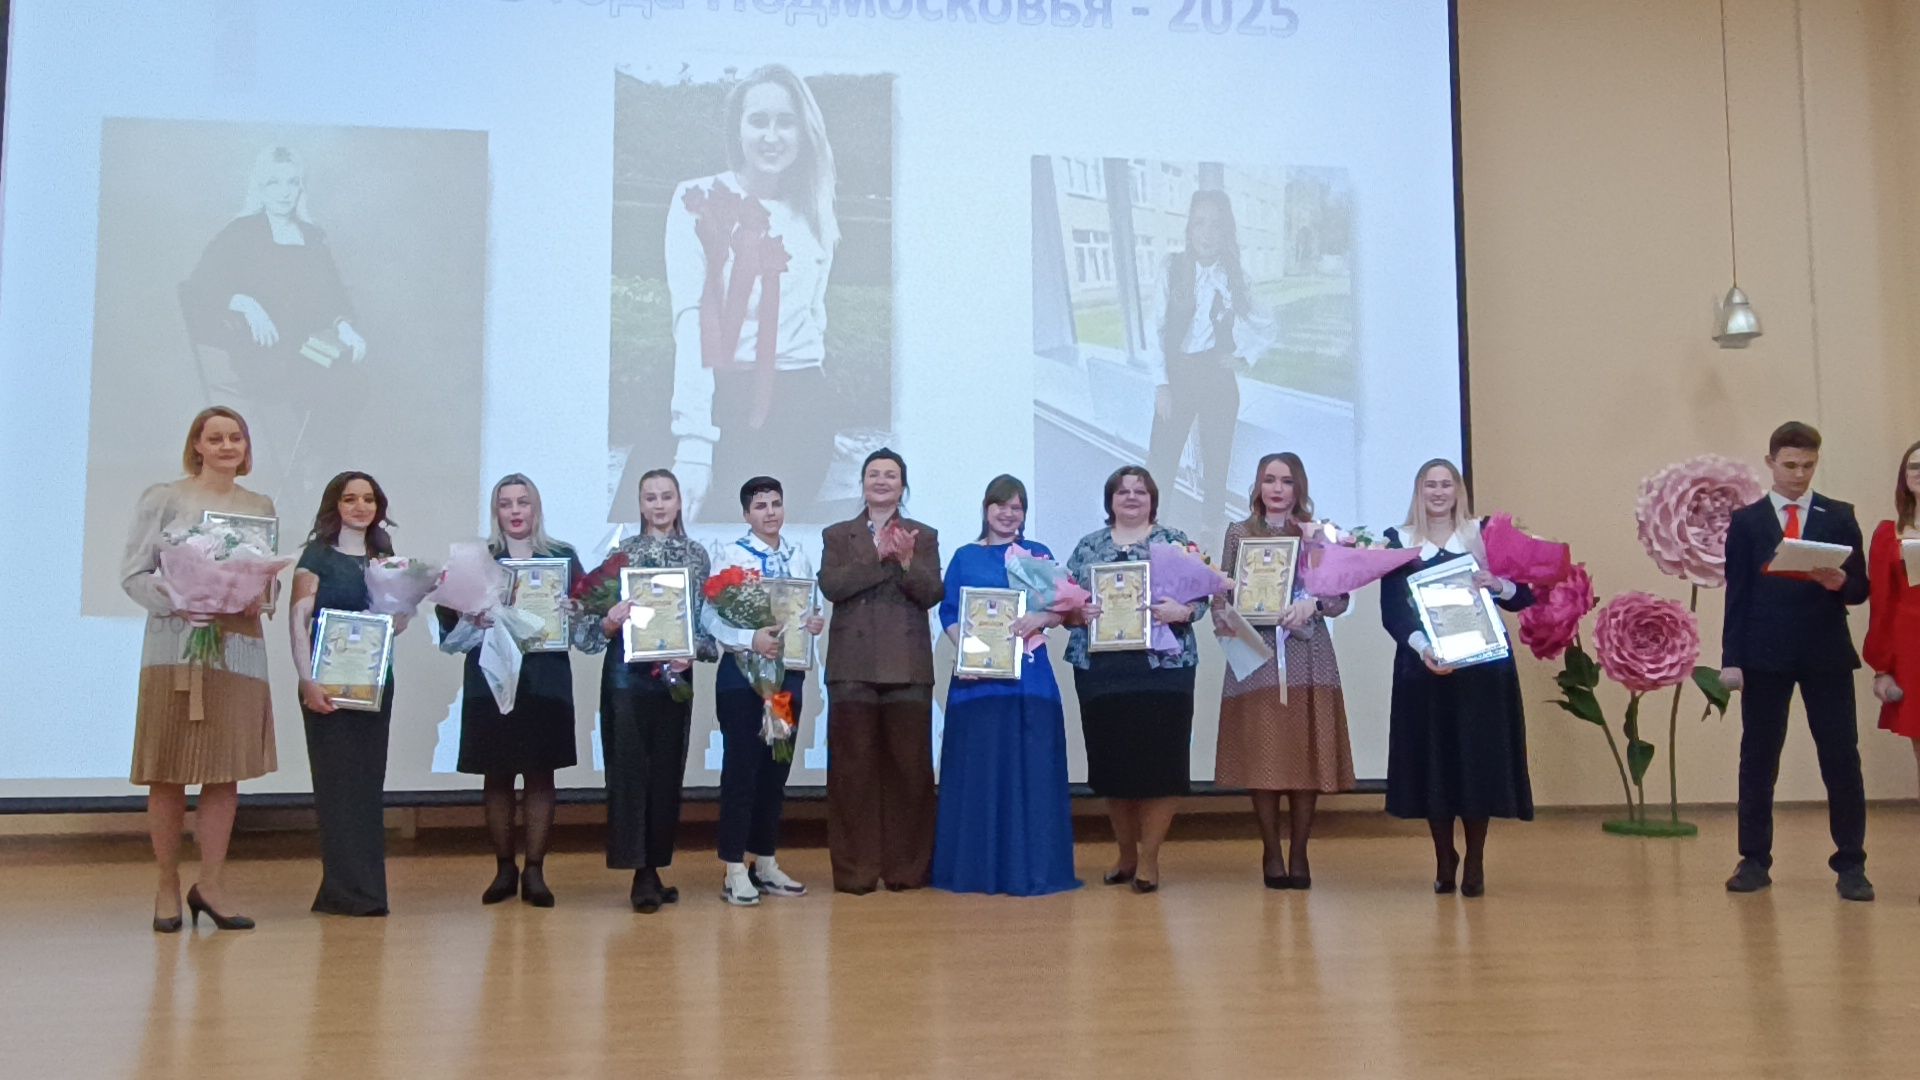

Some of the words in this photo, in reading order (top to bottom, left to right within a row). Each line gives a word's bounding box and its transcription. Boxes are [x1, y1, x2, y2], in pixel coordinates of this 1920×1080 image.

[707, 0, 1112, 29] дмосковья
[1132, 6, 1150, 16] -
[1168, 0, 1299, 38] 2025
